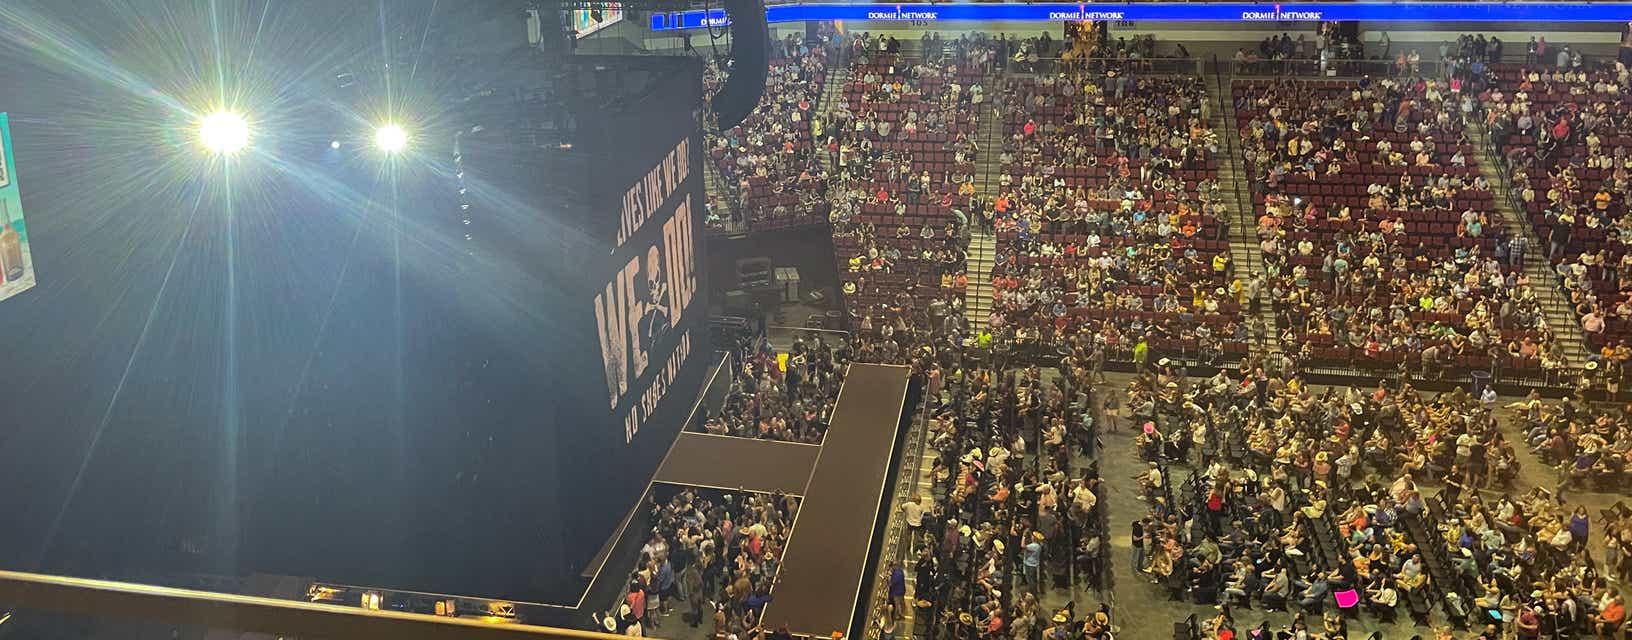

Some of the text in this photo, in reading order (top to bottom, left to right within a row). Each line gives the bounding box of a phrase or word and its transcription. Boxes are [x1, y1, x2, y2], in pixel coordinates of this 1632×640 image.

[644, 163, 664, 218] LIKE
[663, 149, 677, 198] WE
[594, 193, 697, 410] WE DO!
[625, 405, 638, 444] NO
[641, 368, 666, 423] SHOES
